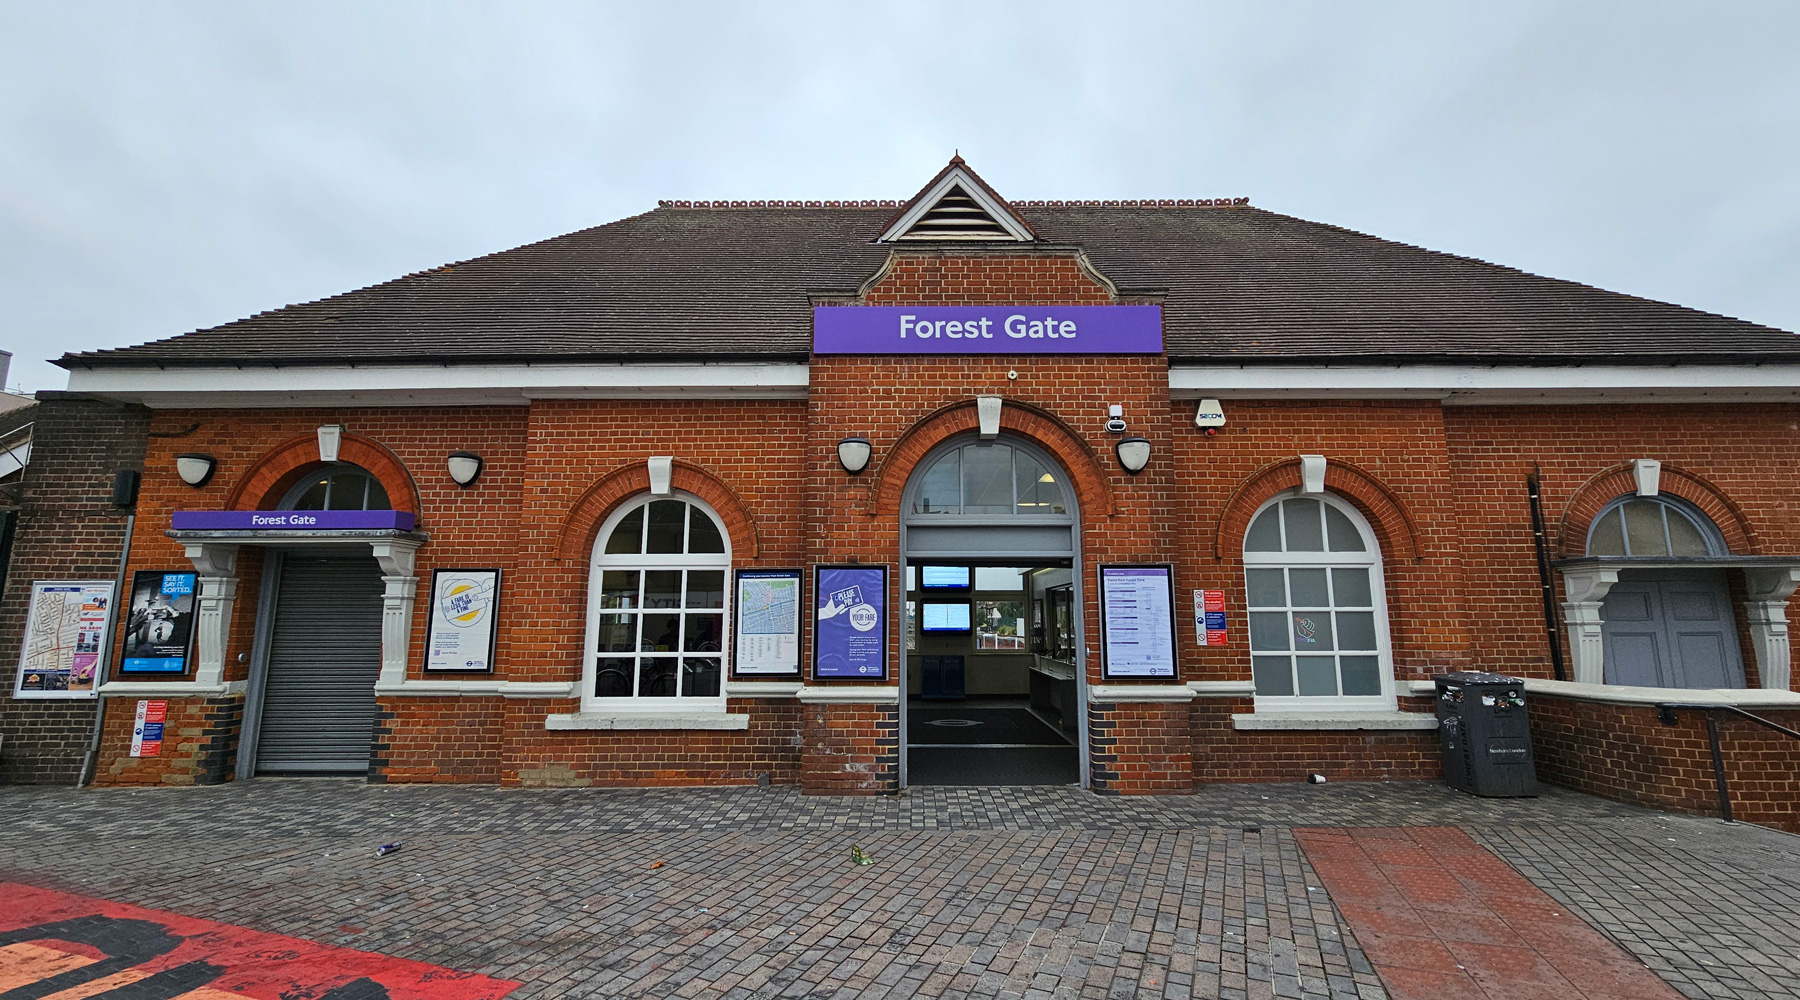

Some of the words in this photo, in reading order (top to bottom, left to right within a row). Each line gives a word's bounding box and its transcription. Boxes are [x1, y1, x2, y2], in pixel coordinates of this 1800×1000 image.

[900, 315, 993, 338] Forest
[1004, 314, 1076, 338] Gate
[252, 515, 286, 525] Forest
[290, 514, 316, 524] Gate
[454, 596, 463, 604] FARE
[838, 589, 855, 600] PLEASE
[844, 598, 853, 606] PAY
[1463, 748, 1472, 786] FOREST
